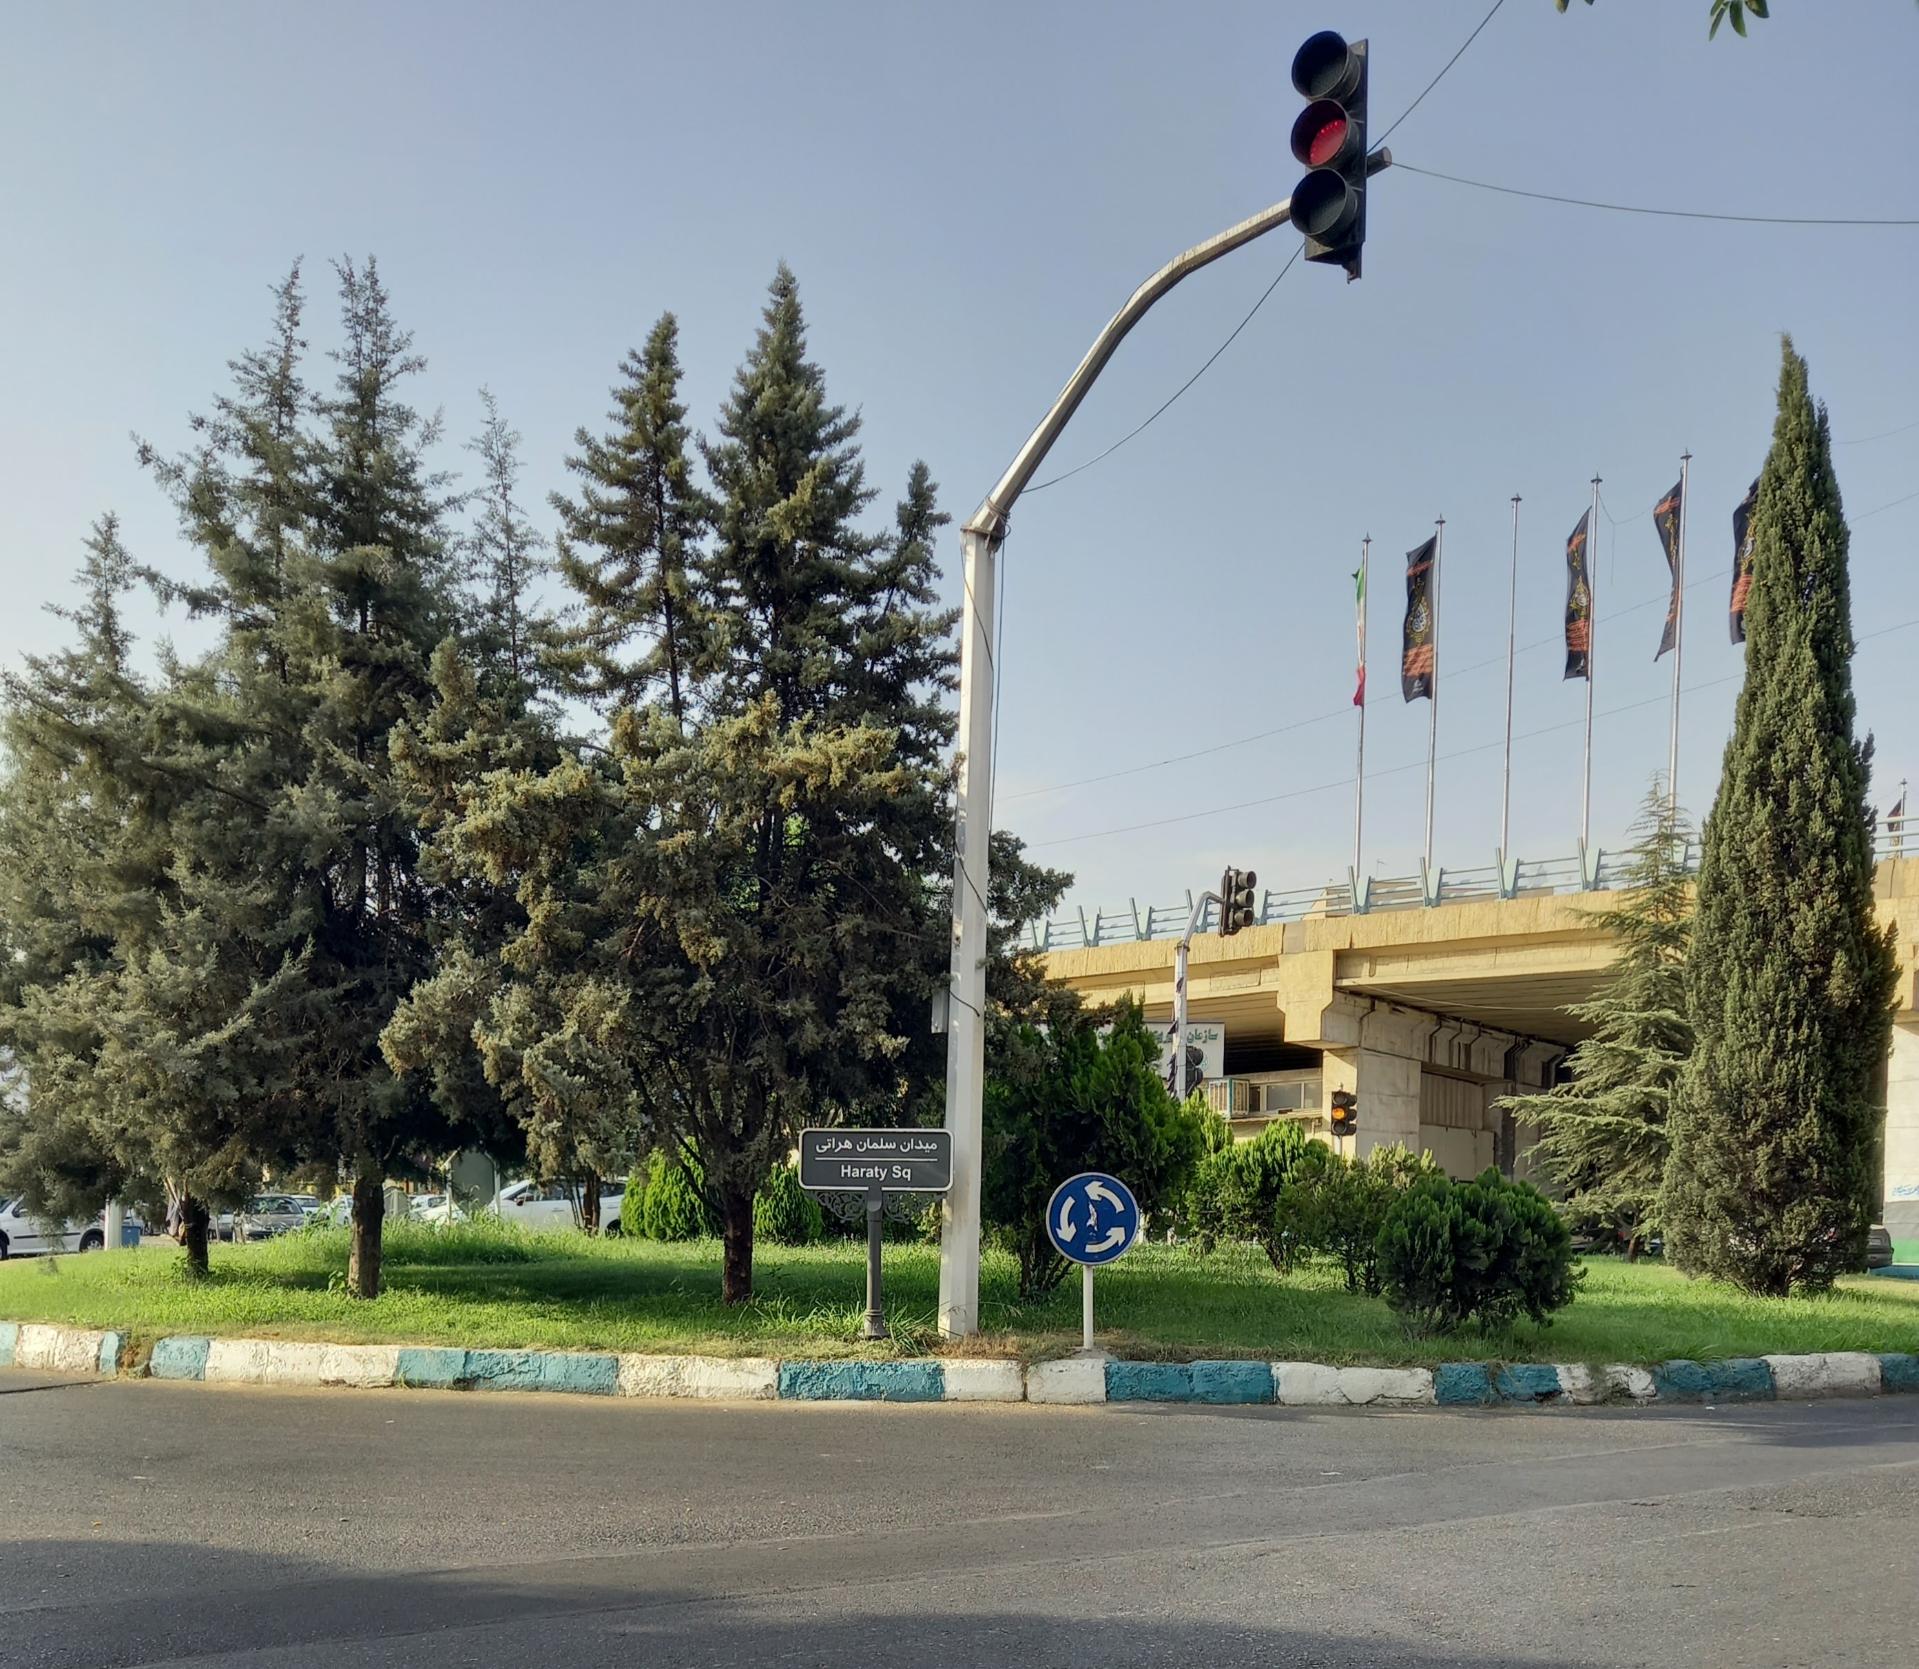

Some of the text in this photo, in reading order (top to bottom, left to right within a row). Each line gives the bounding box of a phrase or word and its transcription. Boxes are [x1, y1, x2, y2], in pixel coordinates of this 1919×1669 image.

[815, 1137, 938, 1154] میدان سلمان هراتی
[841, 1165, 911, 1181] Haraty Sq
